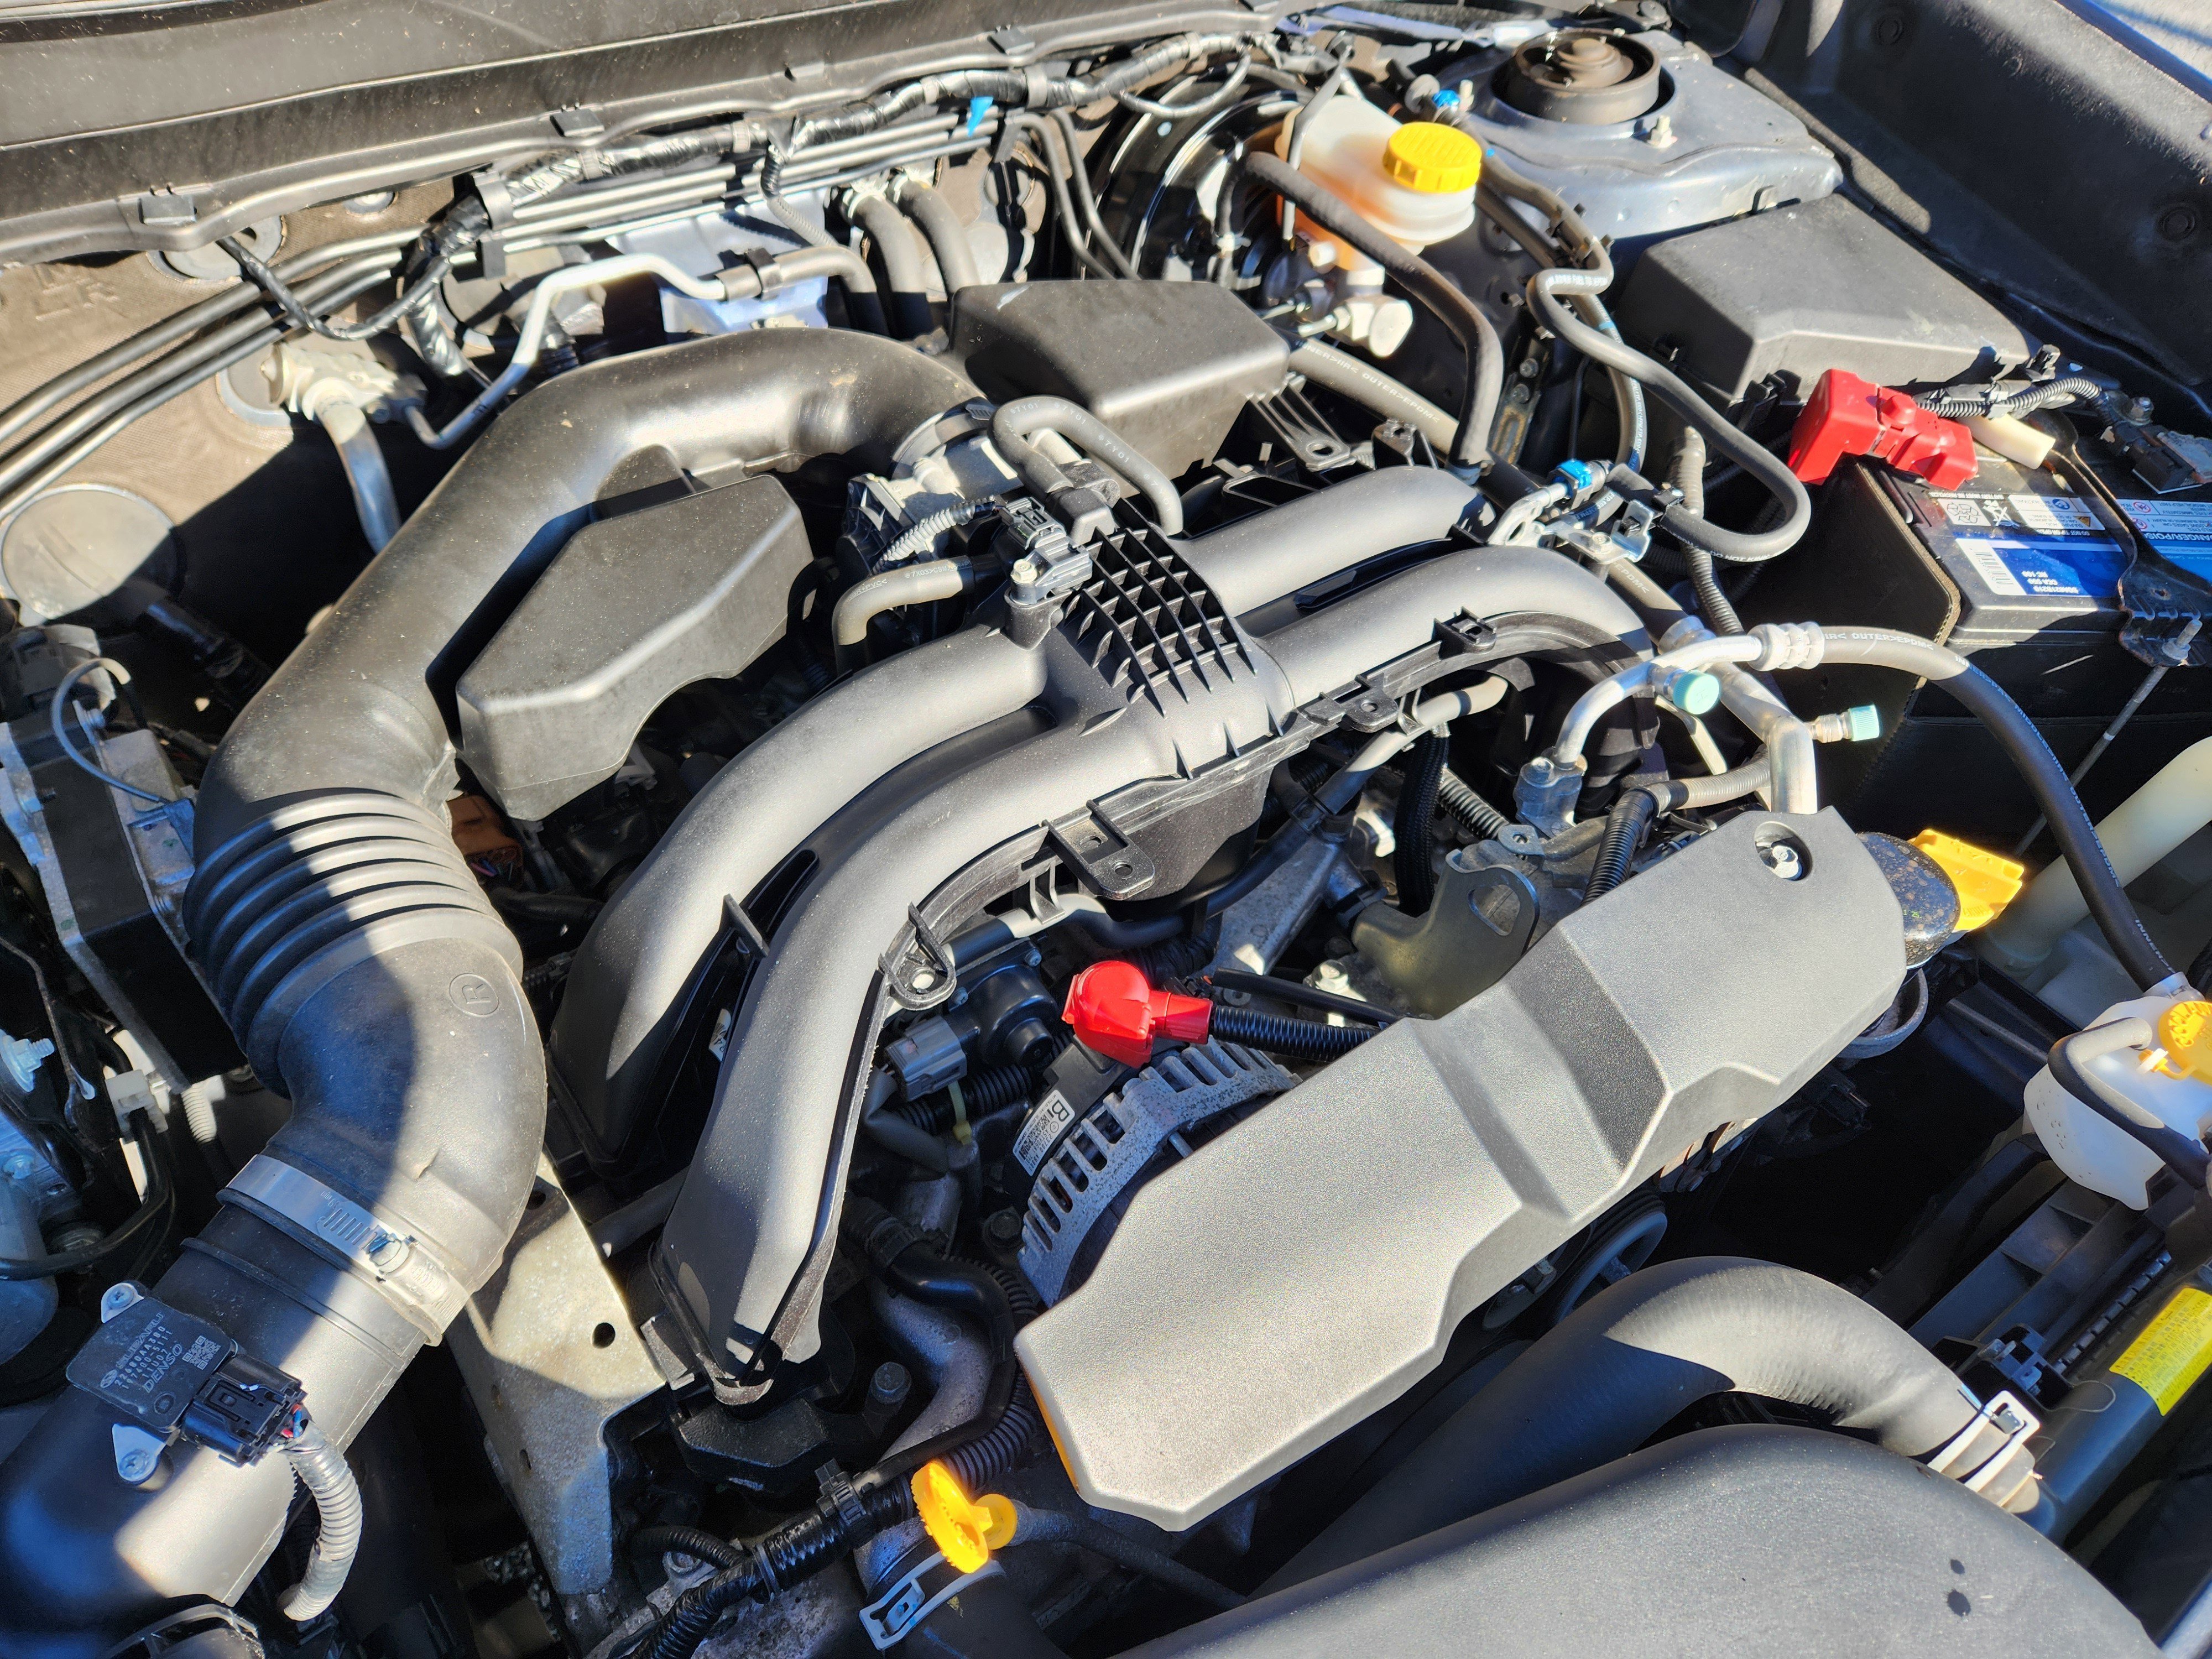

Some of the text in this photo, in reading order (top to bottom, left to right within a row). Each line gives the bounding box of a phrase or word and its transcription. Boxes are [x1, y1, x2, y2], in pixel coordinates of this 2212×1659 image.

[1361, 372, 1440, 423] OUTER>EPDM<
[1851, 633, 1933, 651] OUTER>EPDM<
[1039, 1133, 1053, 1152] 23700
[113, 1324, 166, 1386] 22680AA380
[115, 1312, 164, 1370] SUBARU
[121, 1329, 173, 1389] 197400-5111
[142, 1342, 185, 1393] DENSO
